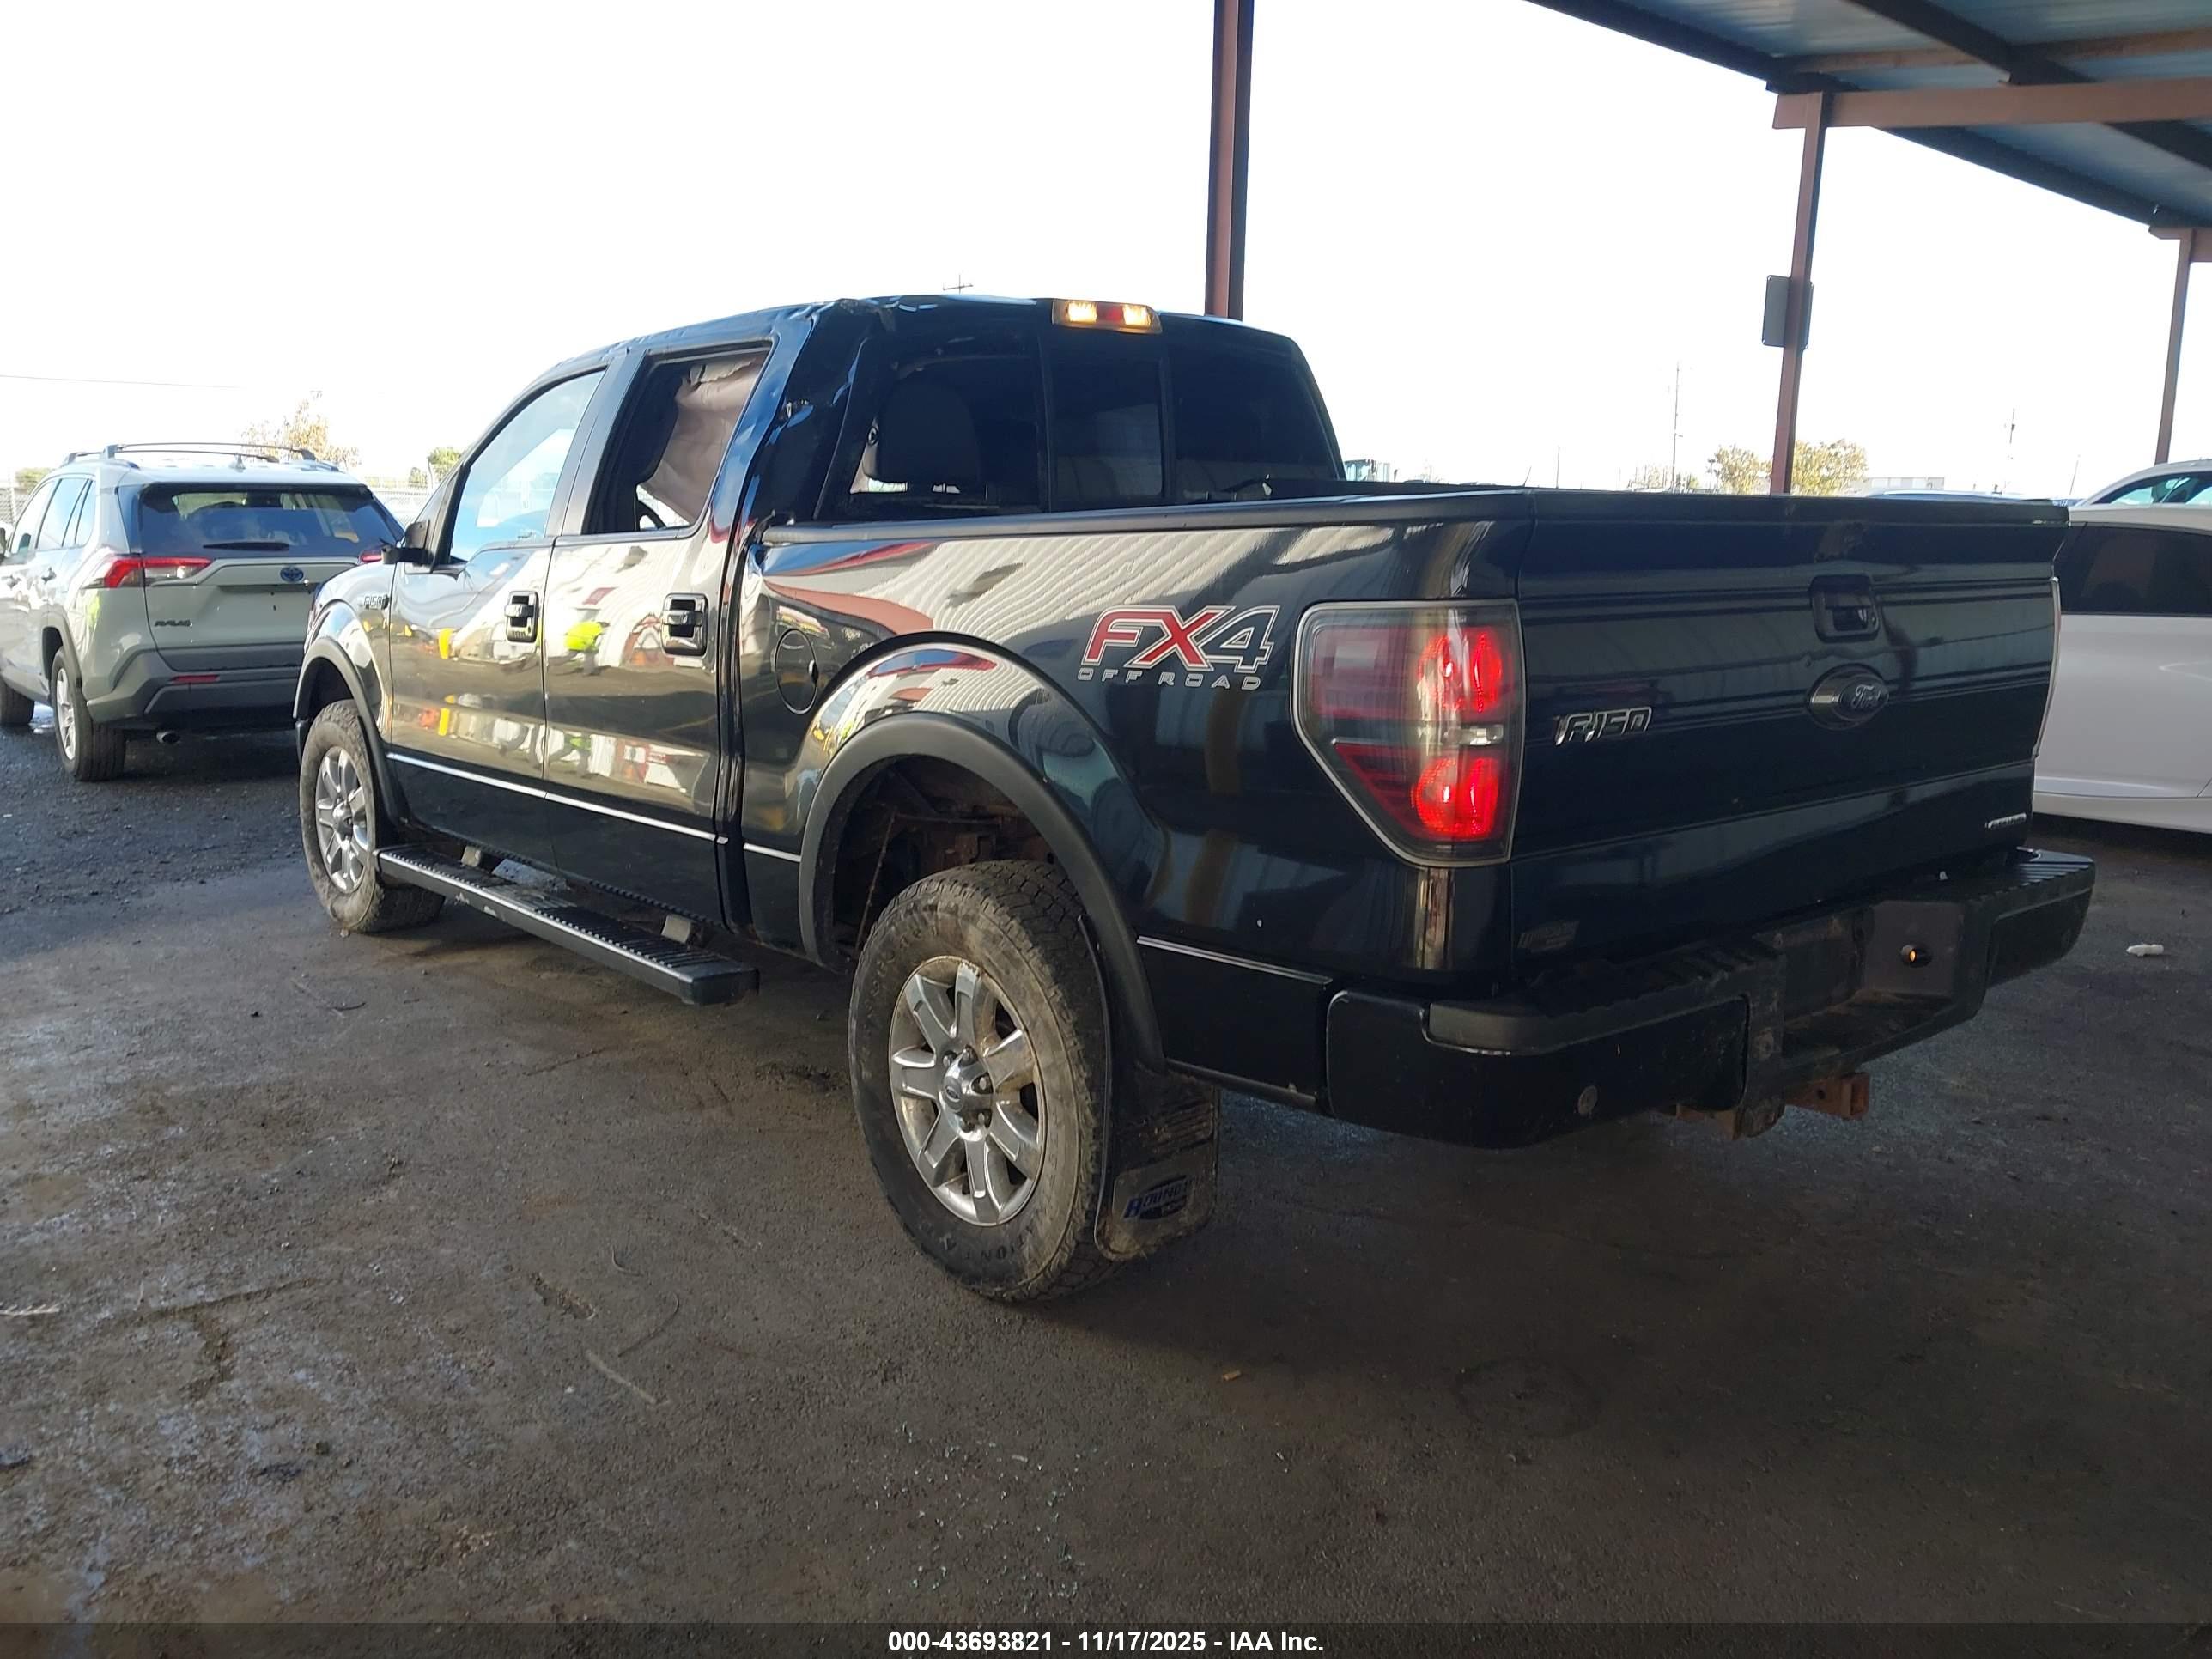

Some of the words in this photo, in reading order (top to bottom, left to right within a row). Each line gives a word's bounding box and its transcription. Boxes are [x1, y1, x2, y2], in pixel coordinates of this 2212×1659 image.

[1080, 605, 1280, 673] FX4
[1077, 667, 1143, 684] OFF
[1158, 672, 1261, 690] ROAD
